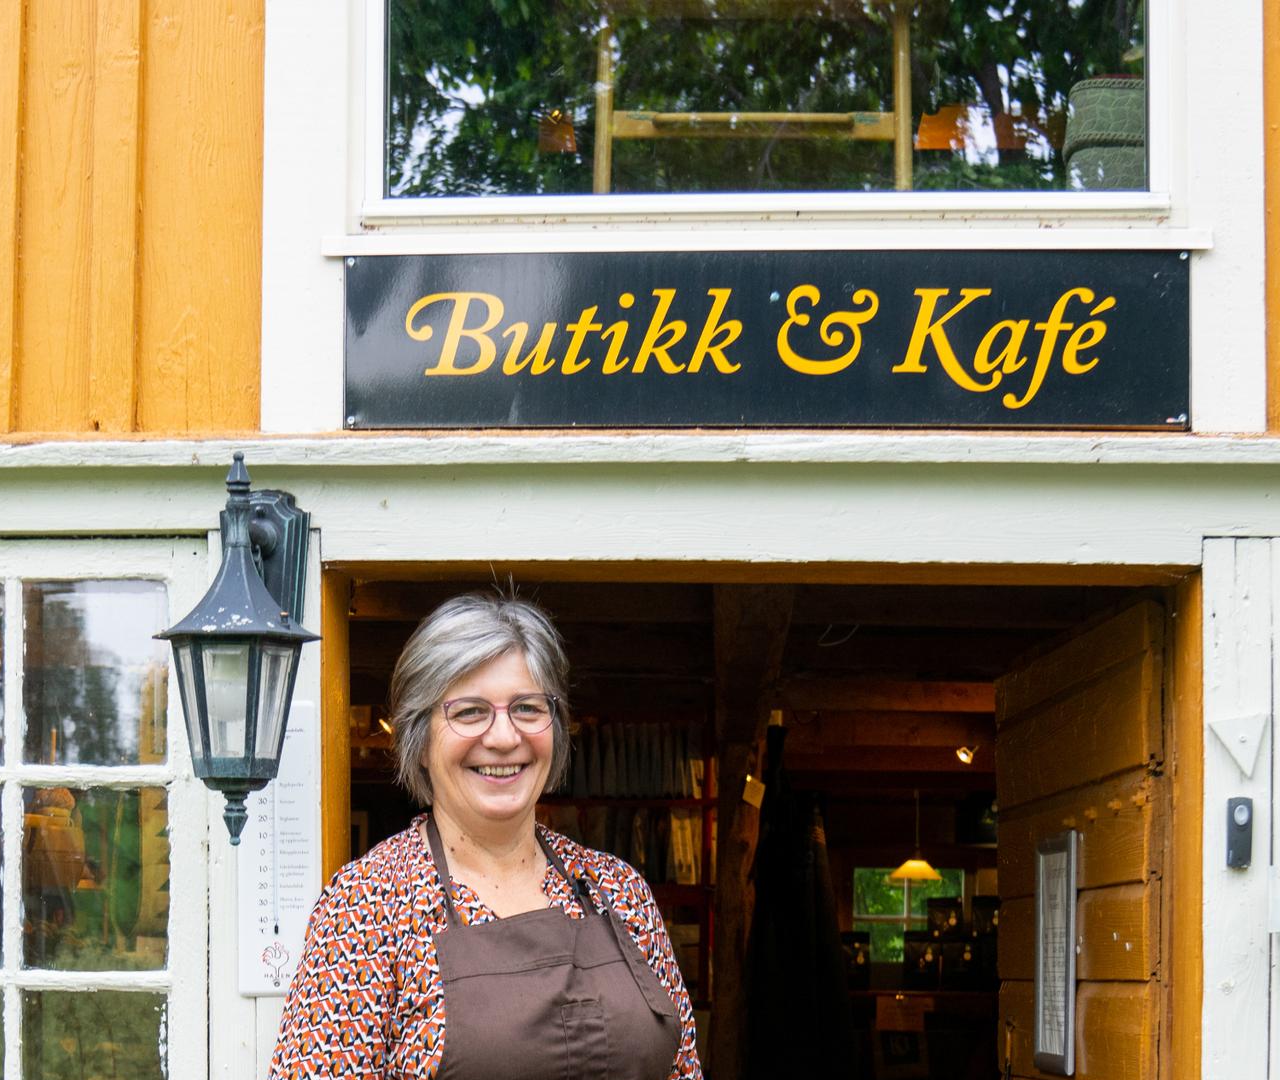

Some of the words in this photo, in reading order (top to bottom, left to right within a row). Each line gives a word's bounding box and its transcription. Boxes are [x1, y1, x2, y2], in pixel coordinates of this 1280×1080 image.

[405, 286, 743, 377] Butikk
[776, 283, 879, 376] &
[892, 285, 1117, 410] Kafé
[258, 814, 268, 822] 20
[258, 832, 268, 840] 10
[259, 848, 266, 856] 0
[259, 865, 268, 873] 10
[258, 881, 268, 890] 20
